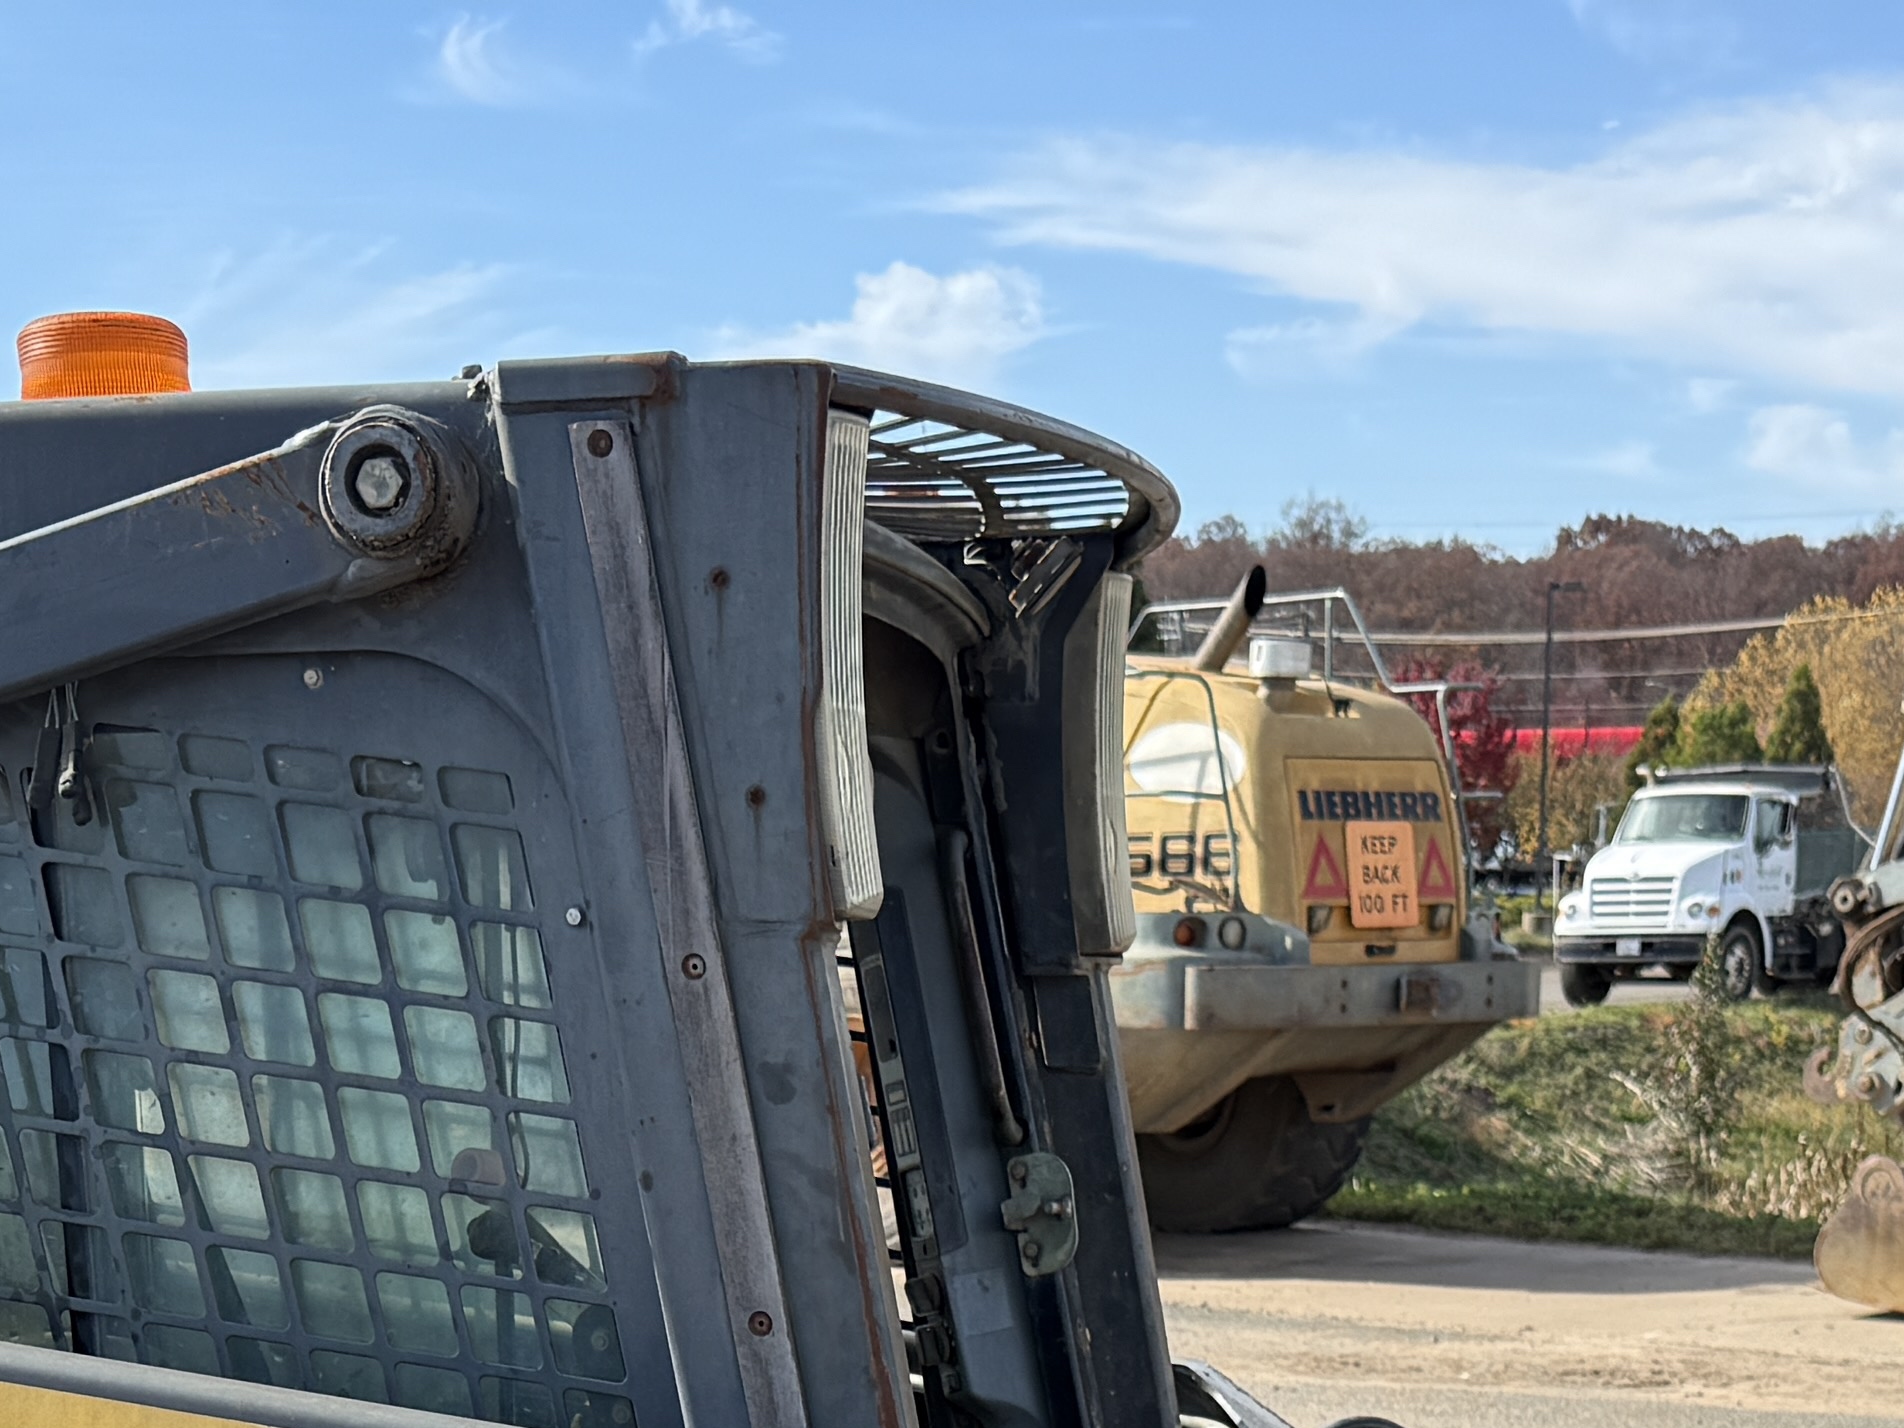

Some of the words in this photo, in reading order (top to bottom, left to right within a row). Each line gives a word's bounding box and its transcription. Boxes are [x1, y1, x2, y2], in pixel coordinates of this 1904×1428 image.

[1297, 789, 1442, 821] LIEBHERR
[1360, 835, 1398, 855] KEEP
[1362, 865, 1401, 884] BACK
[1358, 893, 1385, 914] 100
[1391, 894, 1409, 914] FT
